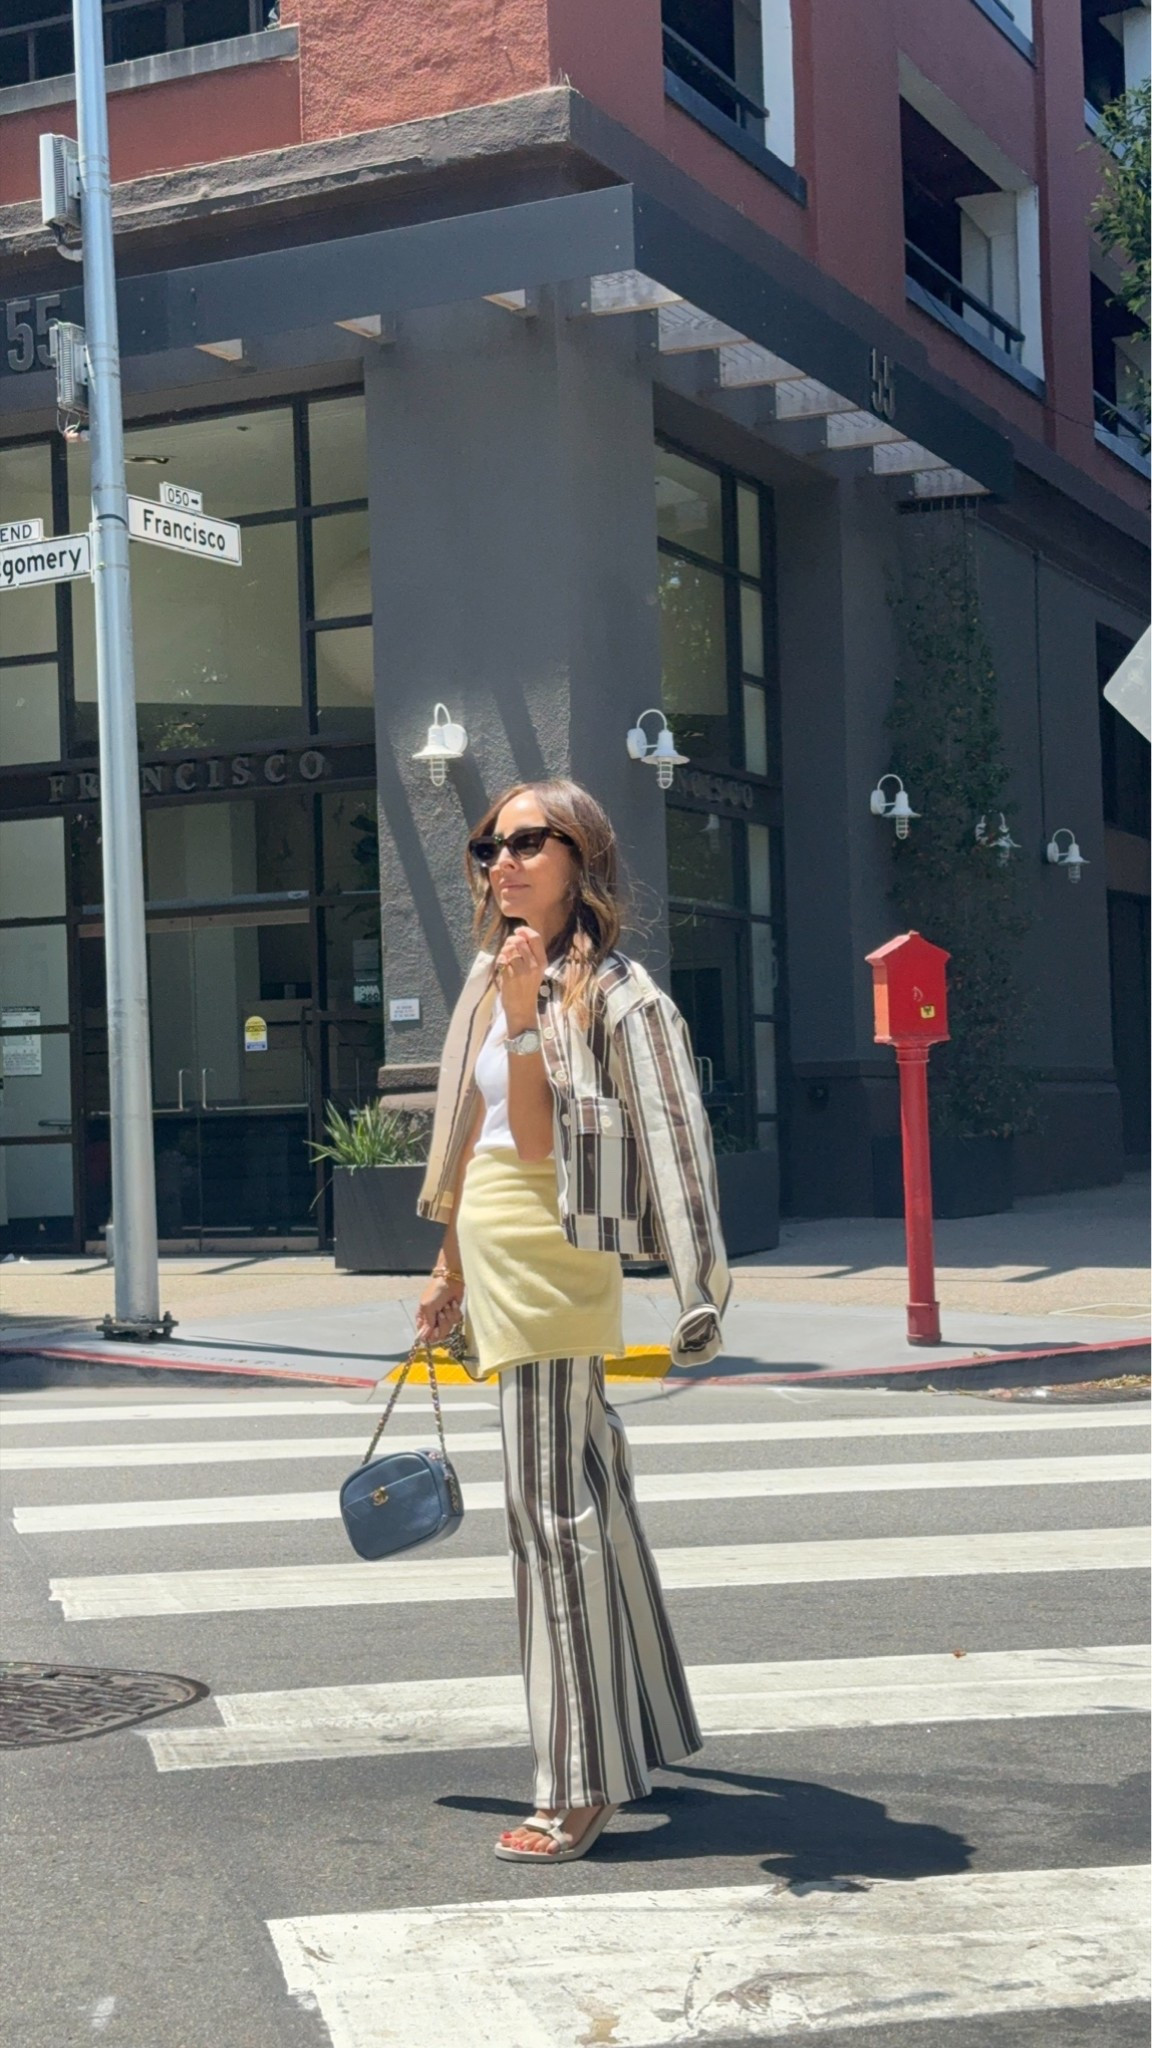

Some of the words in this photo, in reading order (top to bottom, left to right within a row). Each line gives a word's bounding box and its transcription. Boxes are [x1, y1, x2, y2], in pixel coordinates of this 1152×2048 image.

[871, 347, 895, 420] 55
[167, 488, 190, 507] 050
[0, 524, 33, 543] END
[143, 509, 226, 552] Francisco
[0, 547, 82, 584] gomery
[49, 750, 325, 803] FRNCISCO
